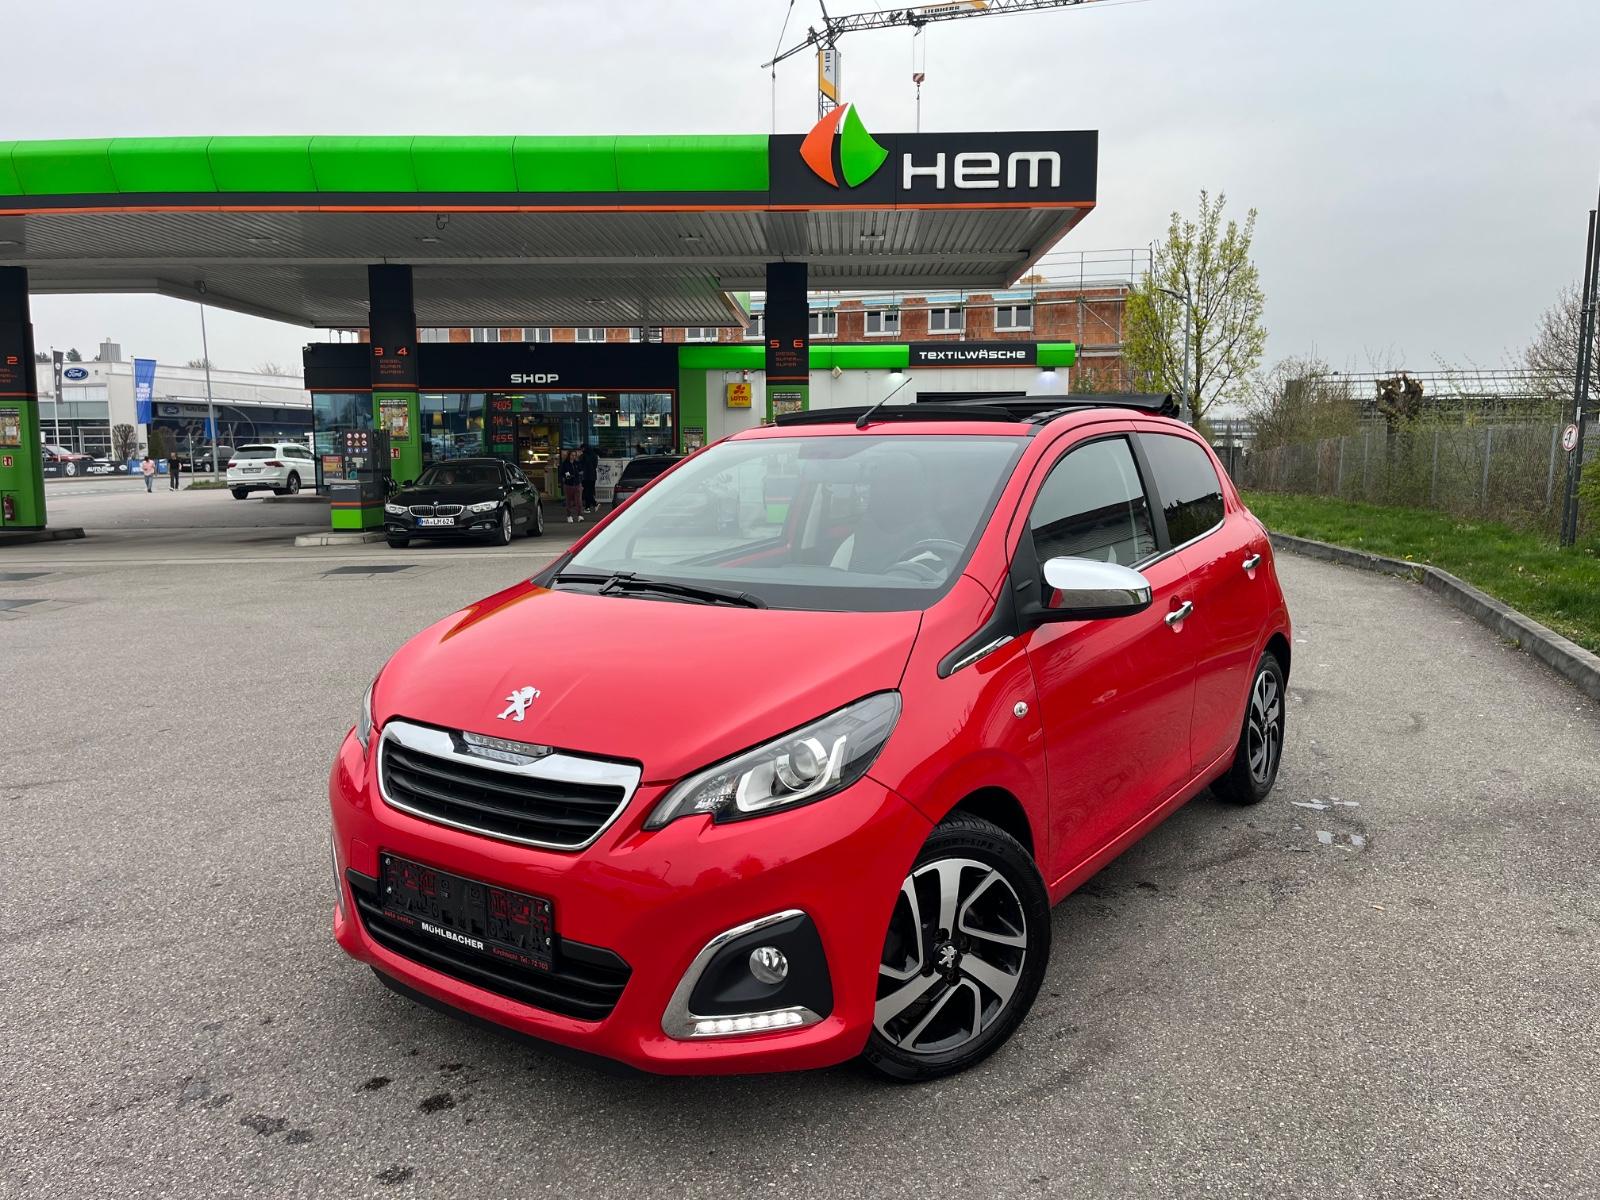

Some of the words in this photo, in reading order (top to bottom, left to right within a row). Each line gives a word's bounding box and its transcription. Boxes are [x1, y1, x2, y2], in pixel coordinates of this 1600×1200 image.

[770, 339, 780, 349] 5
[793, 339, 804, 349] 6
[374, 347, 384, 356] 3
[397, 347, 408, 357] 4
[7, 356, 18, 365] 2
[511, 373, 559, 384] SHOP
[421, 921, 484, 950] MÜHLBACHER
